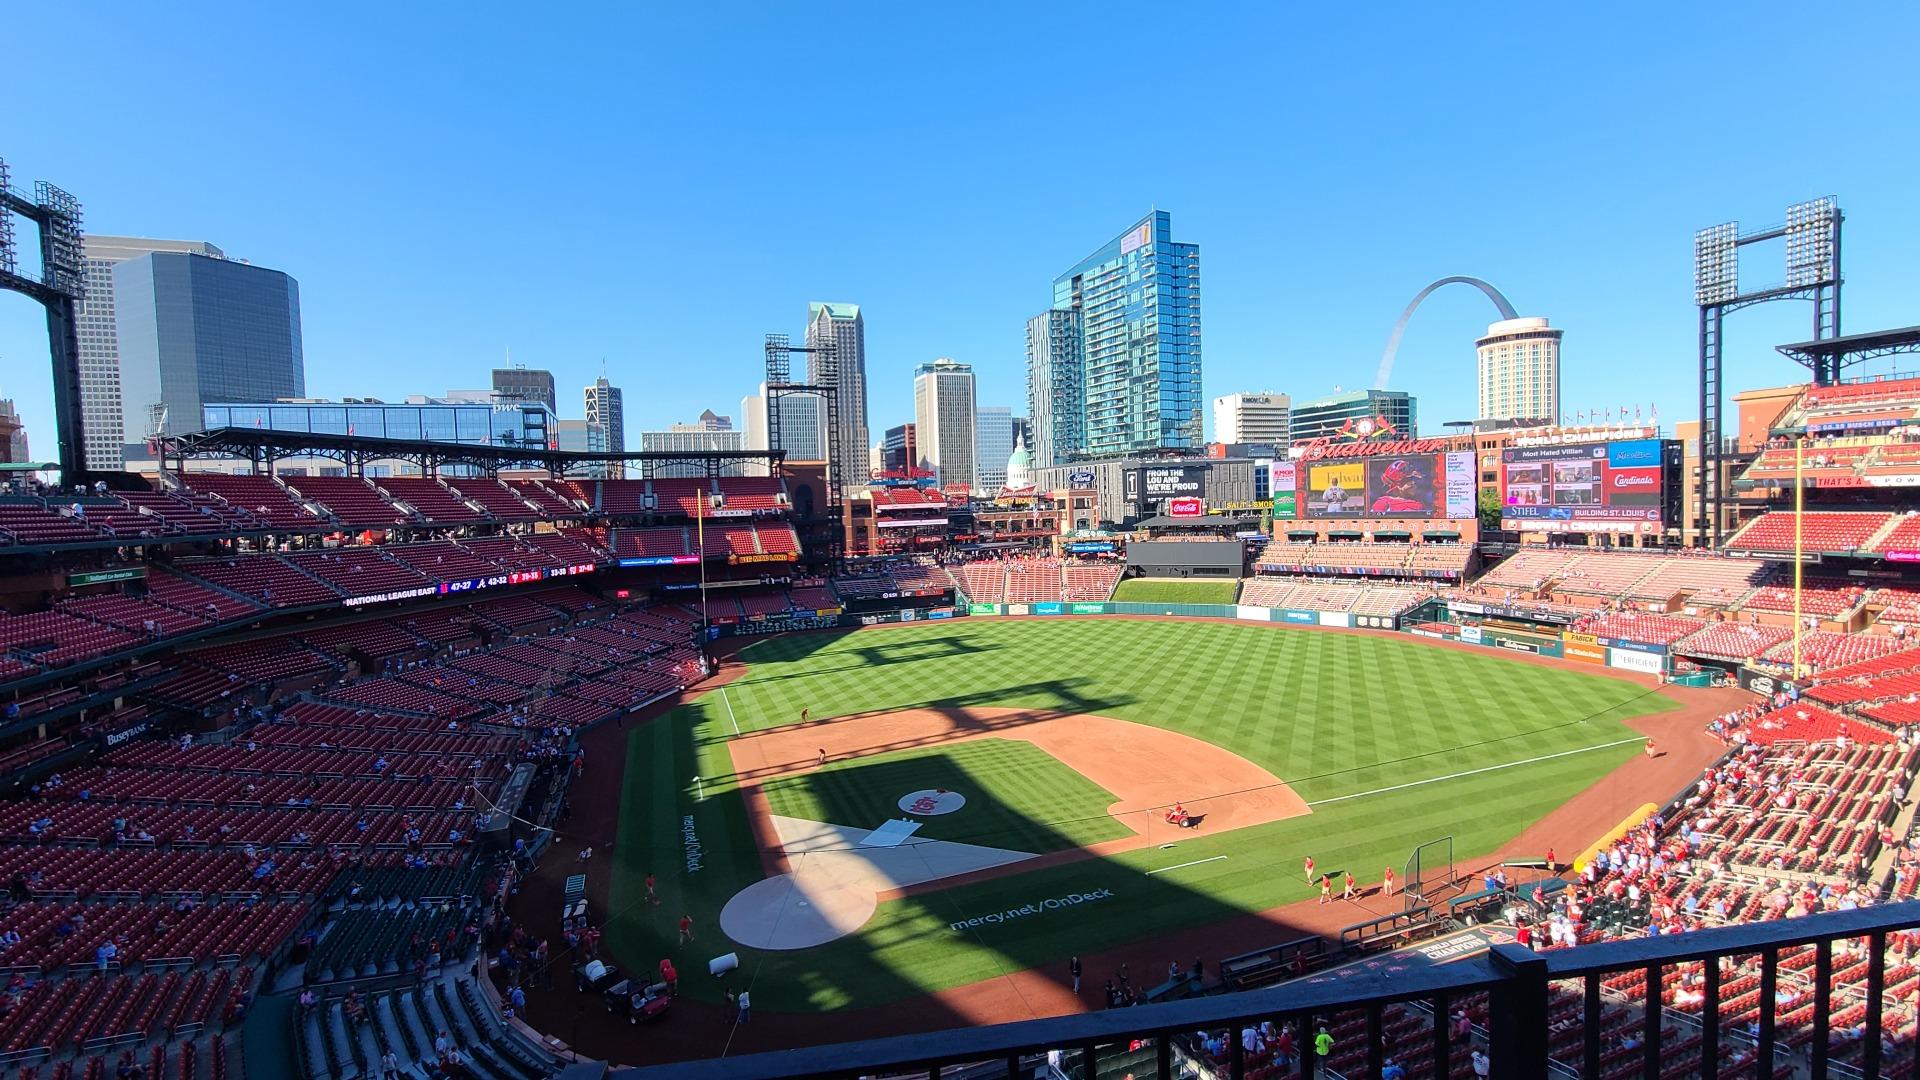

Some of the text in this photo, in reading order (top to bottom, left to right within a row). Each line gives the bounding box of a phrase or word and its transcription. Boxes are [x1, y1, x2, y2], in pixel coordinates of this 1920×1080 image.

[493, 403, 521, 414] pwc
[1517, 429, 1643, 446] WORLD CHAMPIONS
[1295, 437, 1448, 461] Budweiser
[1073, 472, 1091, 482] Ford
[1615, 474, 1654, 487] Cardinals
[1819, 477, 1852, 486] THAT'S
[1173, 503, 1197, 512] Coca-Cola
[1226, 501, 1246, 509] SALT
[1253, 500, 1274, 508] SMOK
[1511, 506, 1540, 517] STIFEL
[1575, 509, 1608, 517] BUILDING
[346, 593, 388, 607] NATIONAL
[388, 589, 418, 601] LEAGUE
[418, 586, 436, 596] EAST
[451, 581, 472, 591] 47-27
[488, 576, 507, 586] 42-32
[1571, 634, 1594, 643] FABICK
[1620, 655, 1658, 668] ERFICIENT
[950, 887, 1116, 931] mercy.net/OnDeck
[1417, 941, 1450, 954] WORLD
[1427, 938, 1487, 960] CHAMPIONS
